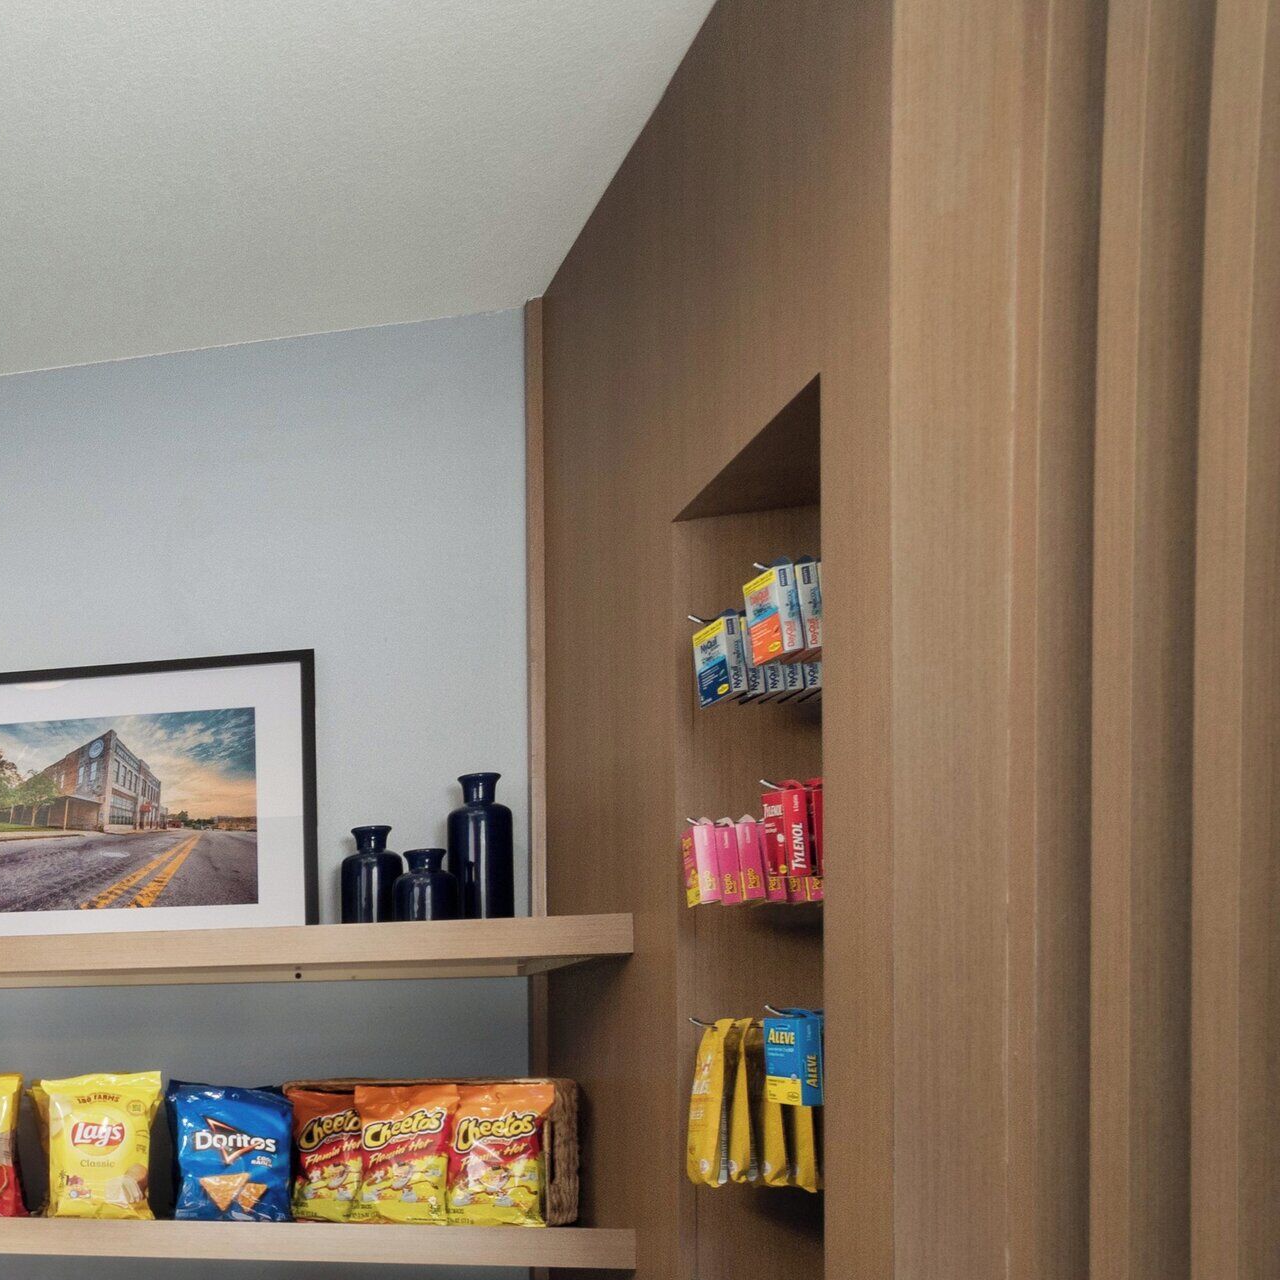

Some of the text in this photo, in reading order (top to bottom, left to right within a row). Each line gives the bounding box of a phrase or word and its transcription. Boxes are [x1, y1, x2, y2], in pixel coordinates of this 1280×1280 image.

[792, 822, 807, 871] TYLENOL
[768, 1028, 795, 1045] ALEVE
[806, 1054, 818, 1088] ALEVE
[300, 1110, 361, 1149] Cheeto
[364, 1110, 444, 1148] Cheetos
[408, 1138, 433, 1151] Hot
[456, 1113, 535, 1152] Cheetos
[80, 1159, 116, 1168] Classic
[503, 1143, 528, 1156] Hot
